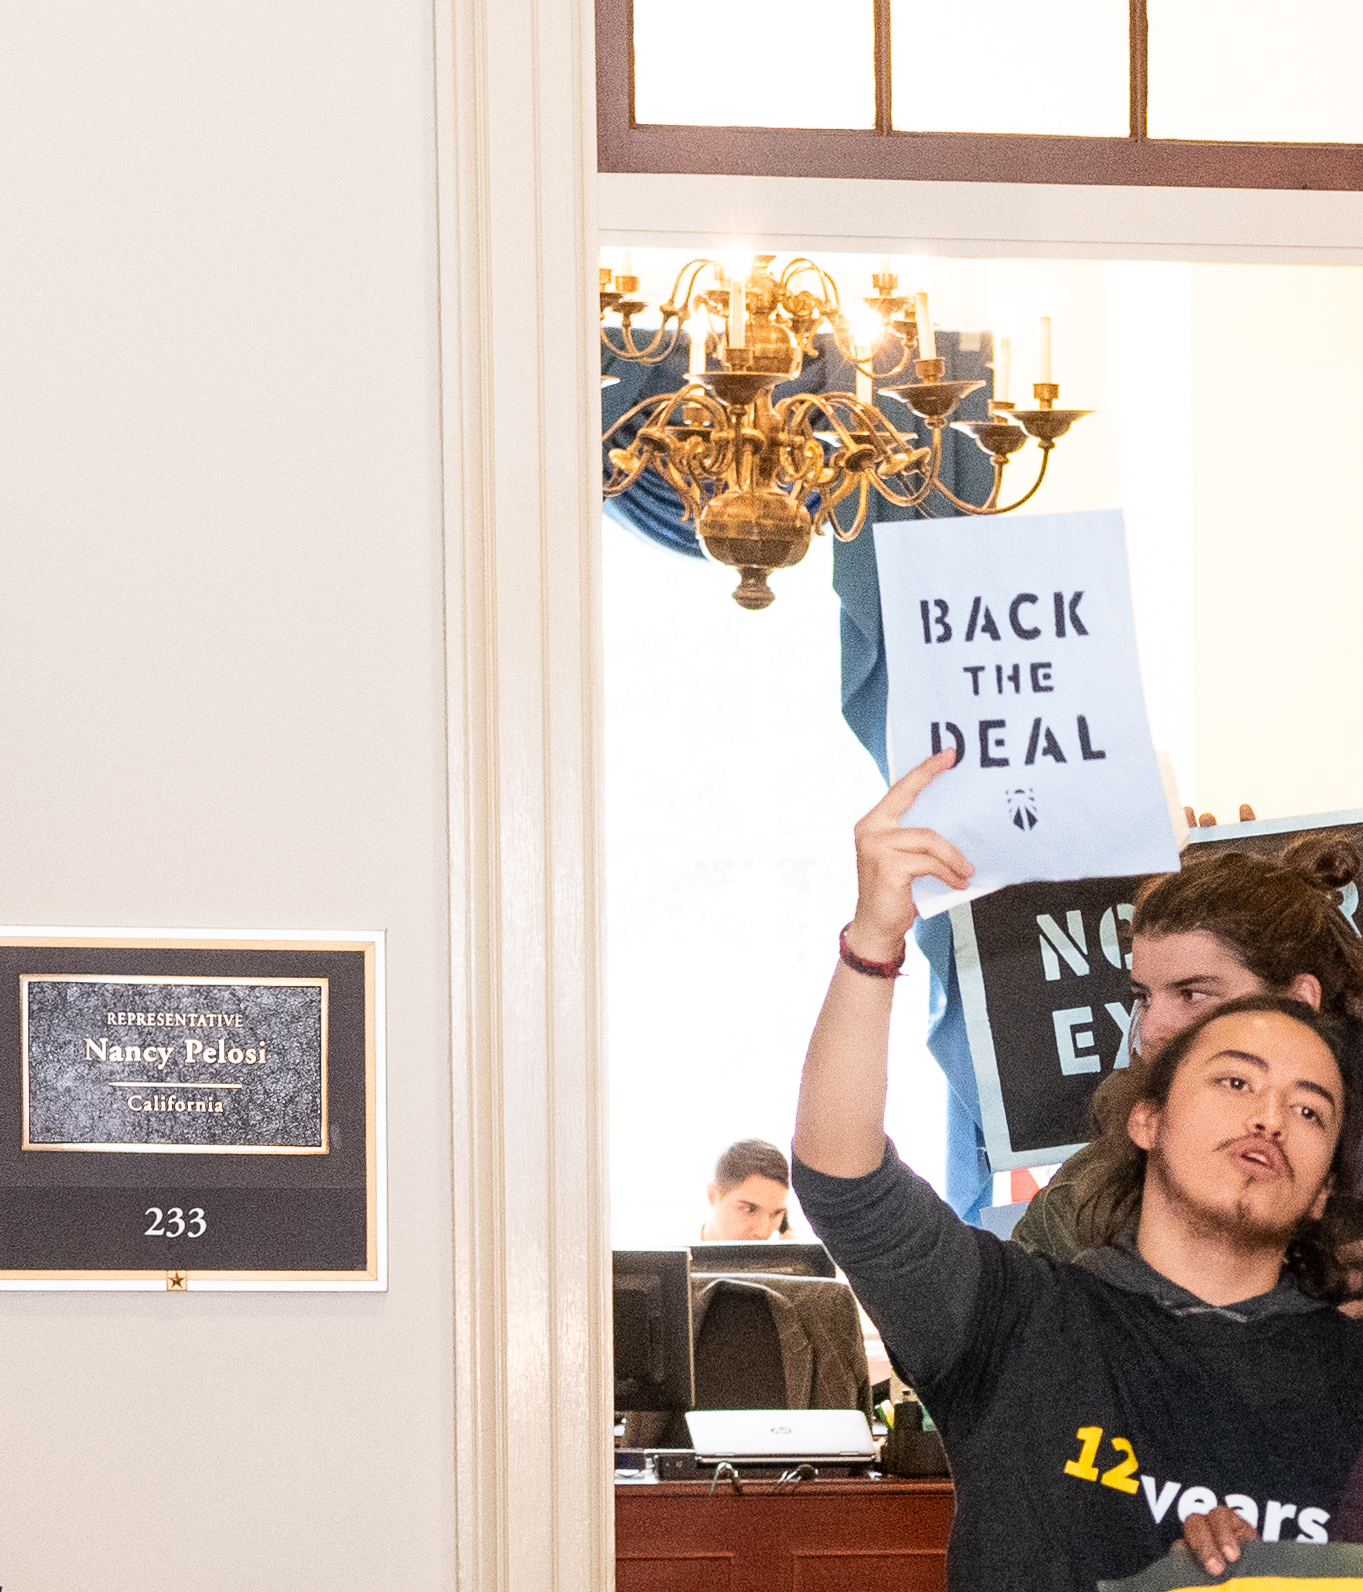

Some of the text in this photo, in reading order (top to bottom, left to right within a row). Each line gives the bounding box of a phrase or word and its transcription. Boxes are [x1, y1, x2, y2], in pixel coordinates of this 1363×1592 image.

[920, 591, 1089, 644] BACK
[963, 662, 1055, 696] THE
[931, 714, 1106, 769] DEAL
[107, 1012, 244, 1028] REPRESENTATIVE
[84, 1037, 267, 1070] Nancy Pelosi
[127, 1095, 223, 1113] California
[144, 1207, 208, 1238] 233
